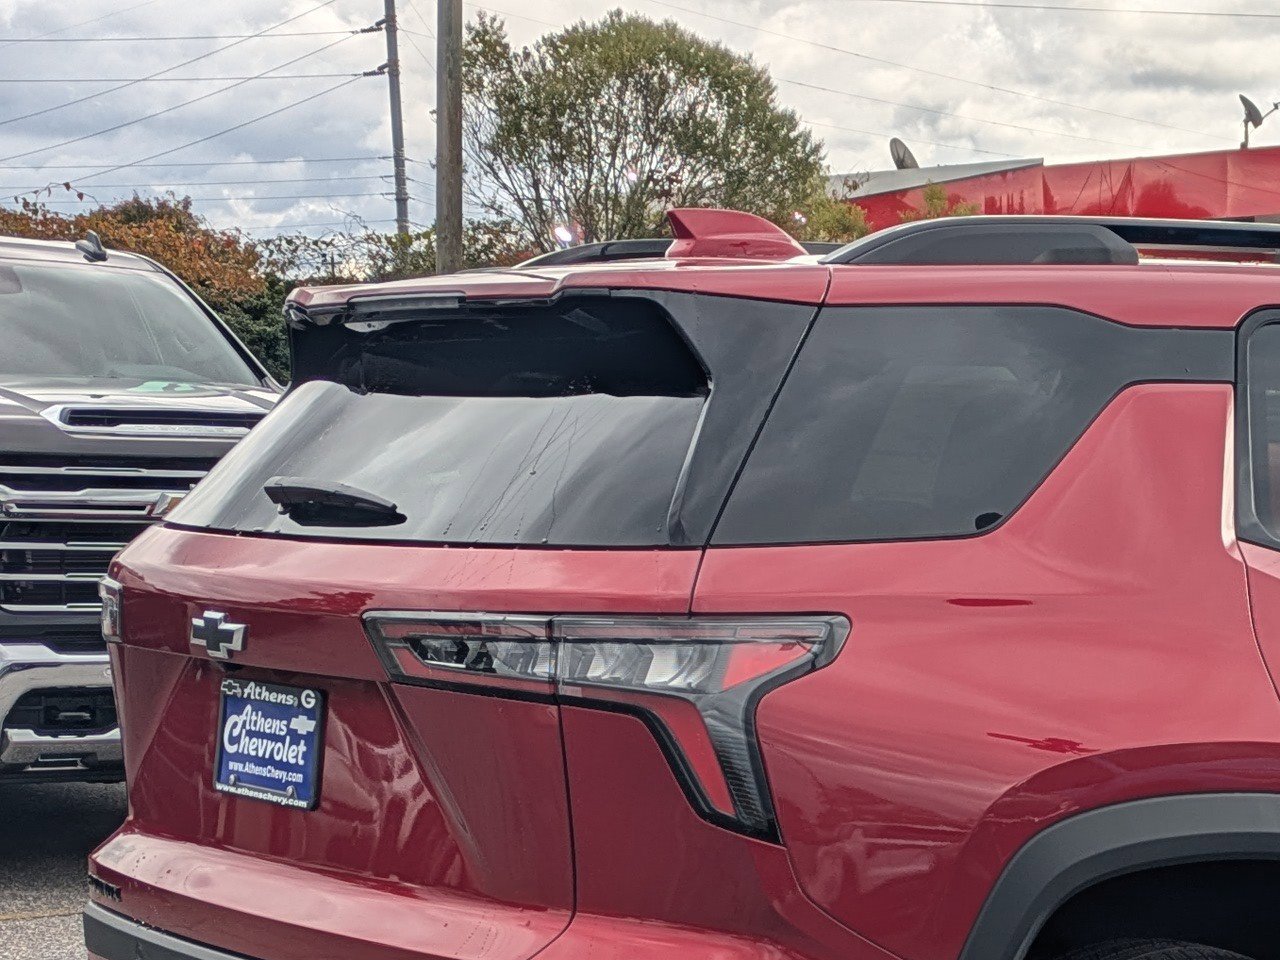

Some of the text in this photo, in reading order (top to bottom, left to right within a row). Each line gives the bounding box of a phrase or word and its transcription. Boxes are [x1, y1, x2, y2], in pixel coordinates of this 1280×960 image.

[300, 689, 316, 709] G
[239, 704, 288, 736] Athens
[223, 714, 307, 766] Chevrolet
[228, 760, 304, 783] www.AthensChevy.com
